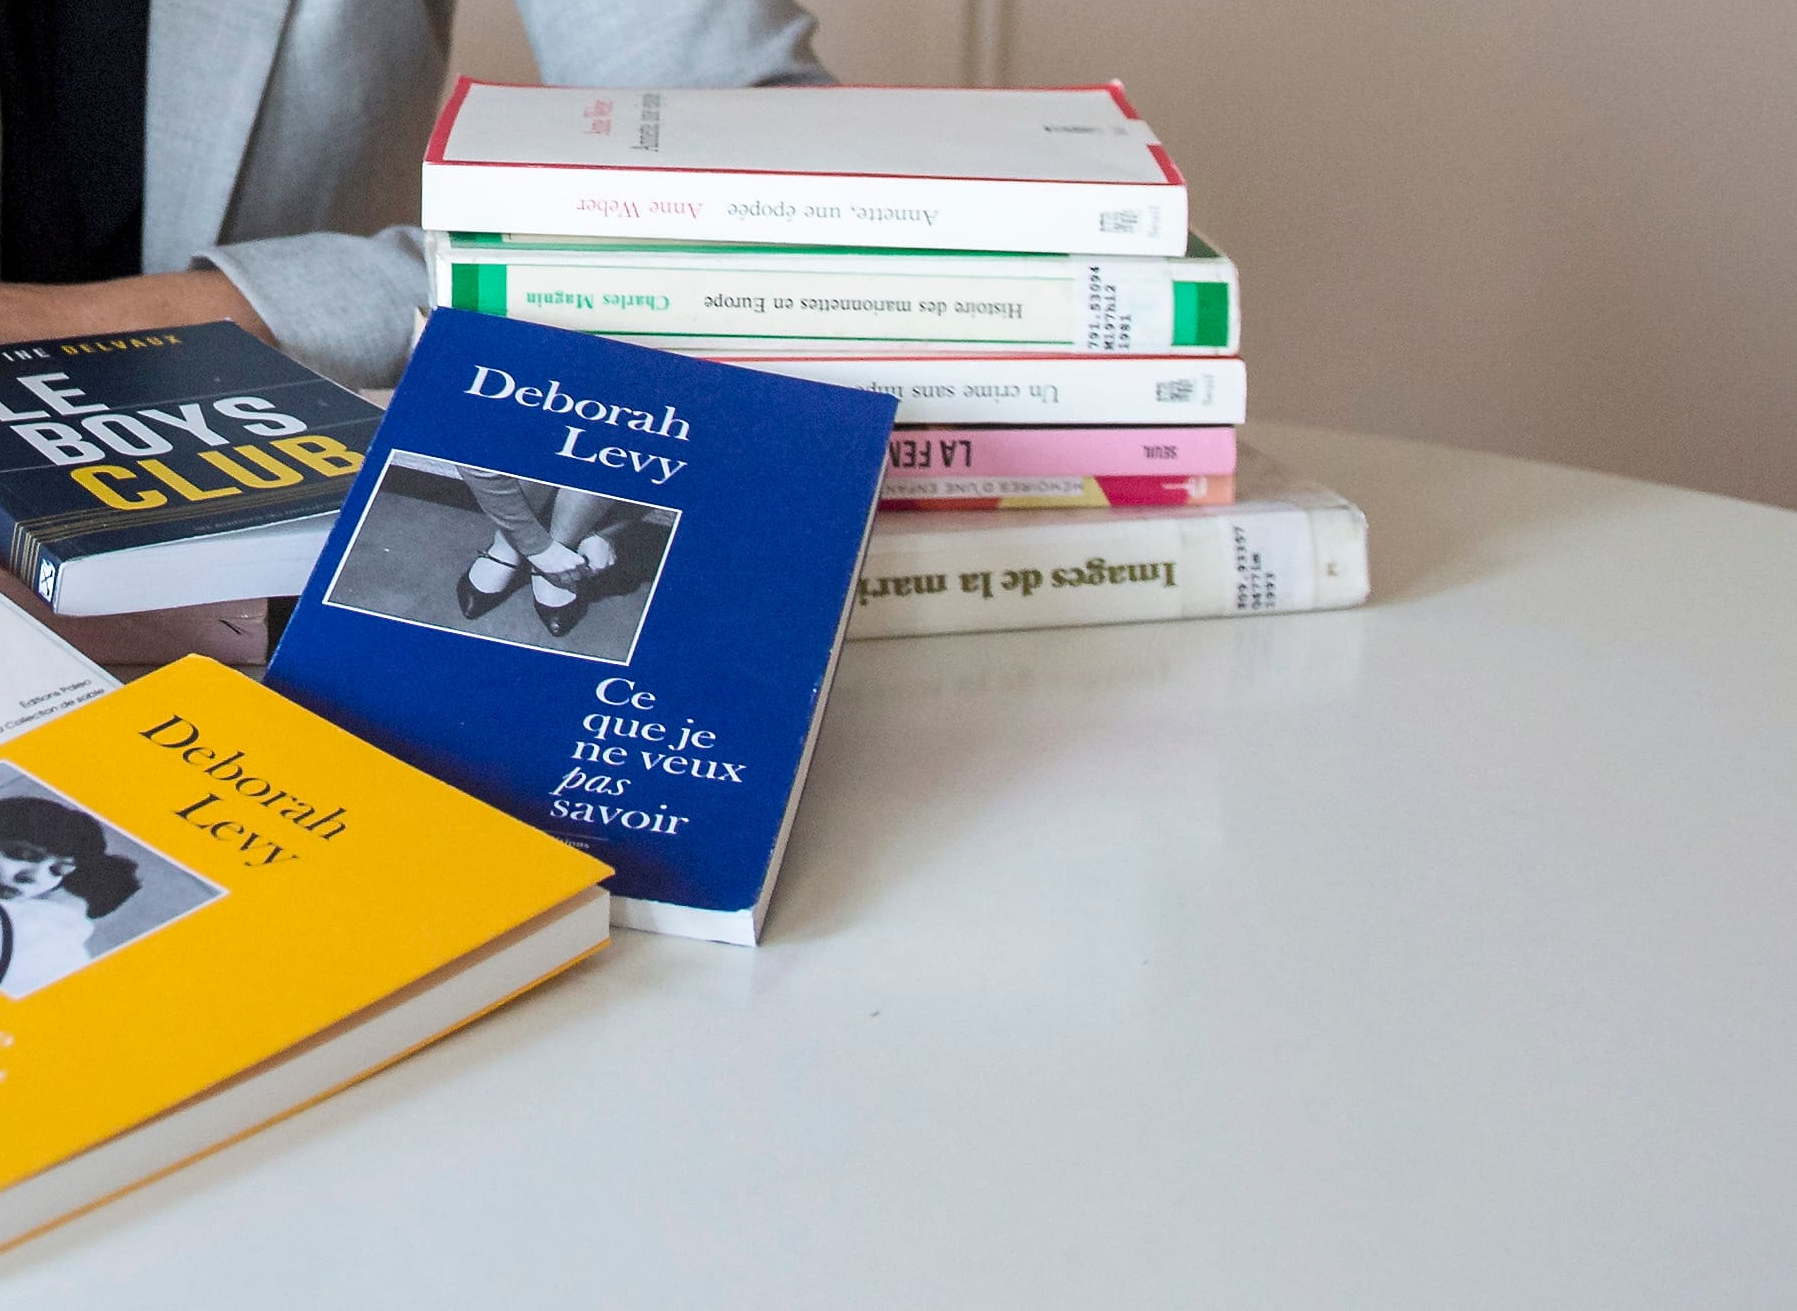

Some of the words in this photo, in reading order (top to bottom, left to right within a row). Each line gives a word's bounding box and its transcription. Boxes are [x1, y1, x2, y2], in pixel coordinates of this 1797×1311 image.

[576, 197, 642, 218] Weber
[648, 202, 703, 219] Anne
[727, 201, 796, 222] épopée
[804, 206, 842, 219] une
[851, 203, 939, 226] Annette,
[525, 291, 594, 310] Magnin
[601, 294, 670, 312] Charles
[703, 293, 765, 313] Europe
[773, 298, 794, 310] en
[800, 297, 912, 314] marionnettes
[919, 300, 948, 317] des
[954, 301, 1023, 320] Histoire
[60, 333, 183, 357] DELVAUX
[464, 364, 691, 442] Deborah
[912, 385, 956, 398] sans
[963, 385, 1021, 403] crime
[1030, 384, 1059, 404] Un
[10, 395, 308, 466] BOYS
[555, 425, 688, 485] Levy
[940, 439, 973, 468] LA
[69, 434, 367, 511] CLUB
[959, 570, 994, 600] la
[1002, 569, 1042, 597] de
[1050, 557, 1177, 591] Images
[858, 573, 947, 607] mari
[595, 676, 657, 710] Ce
[582, 713, 665, 742] que
[668, 717, 717, 751] je
[570, 738, 628, 766] ne
[640, 751, 747, 784] veux
[139, 714, 349, 843] Deborah
[550, 766, 632, 797] pas
[549, 798, 689, 836] savoir
[171, 792, 301, 871] Levy
